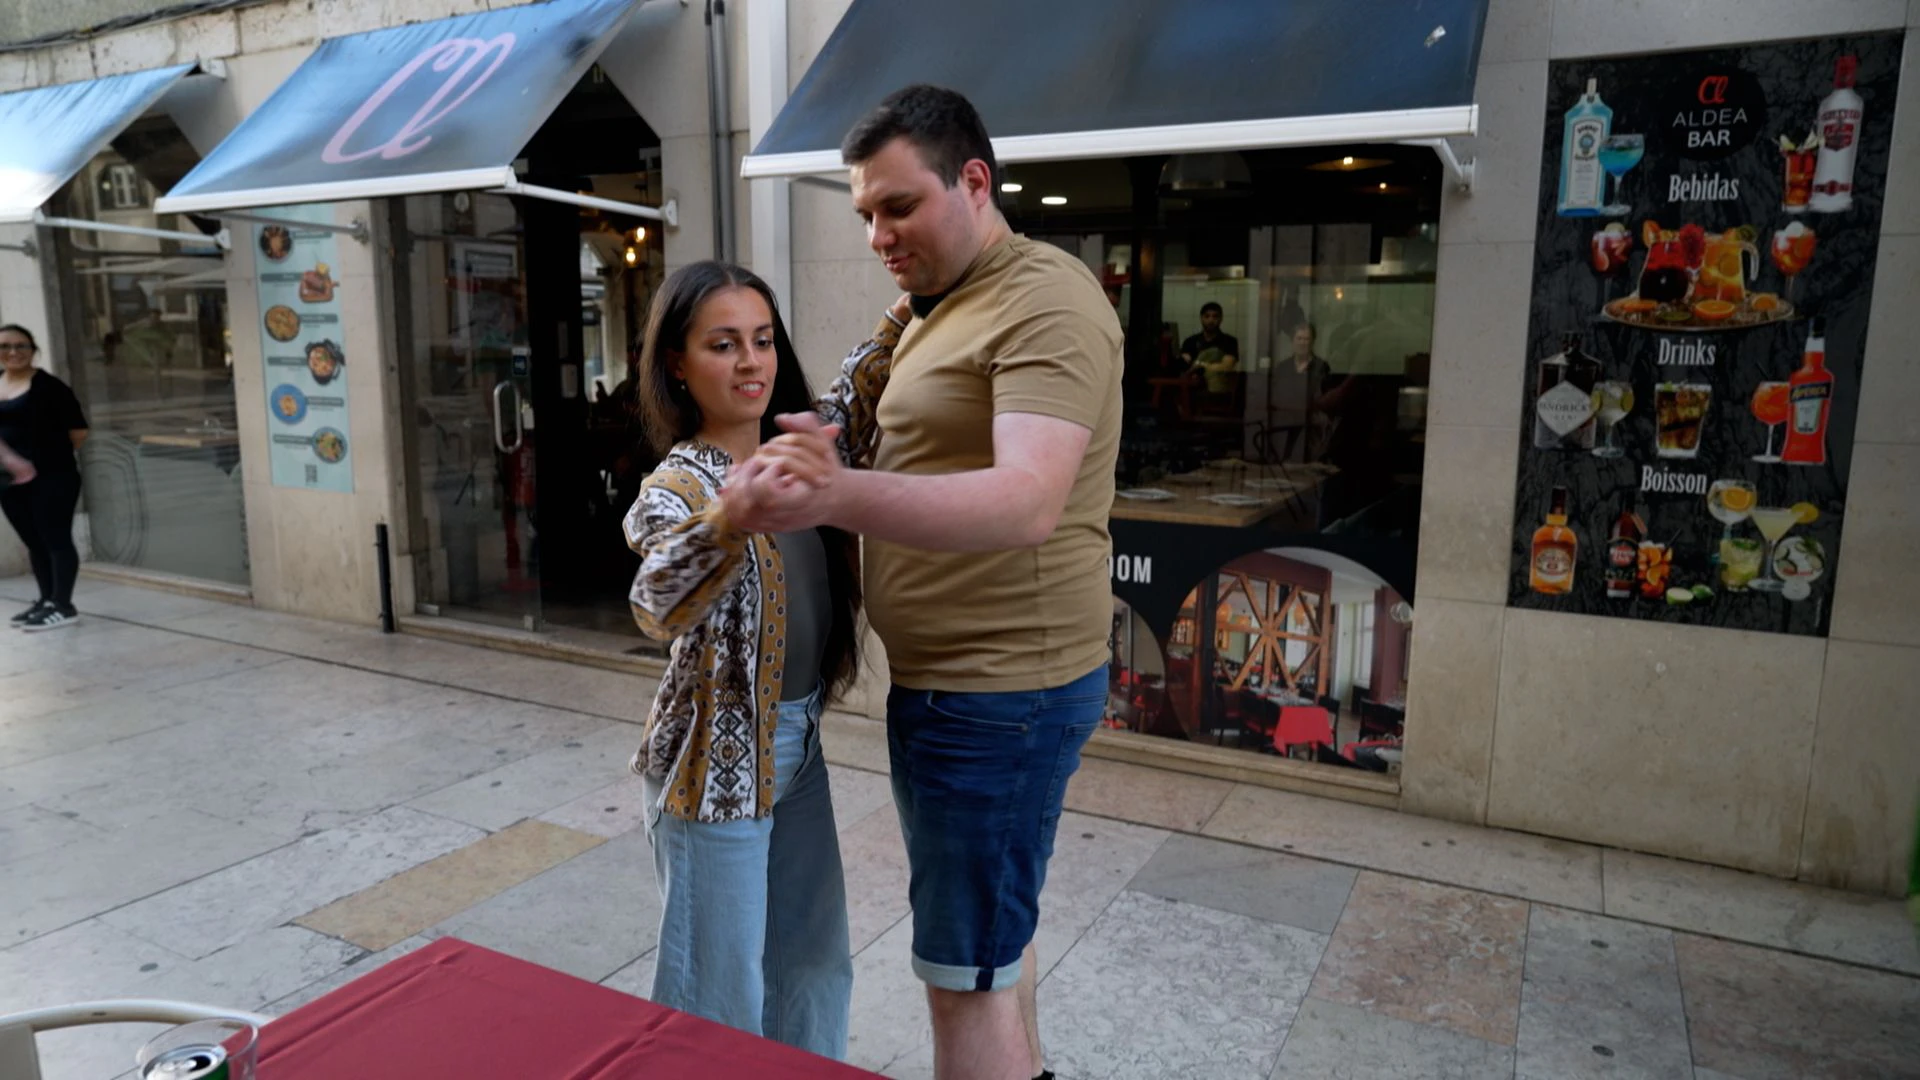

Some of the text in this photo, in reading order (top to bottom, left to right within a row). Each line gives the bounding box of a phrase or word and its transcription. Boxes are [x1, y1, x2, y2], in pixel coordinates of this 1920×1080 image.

[1672, 107, 1748, 128] ALDEA
[1687, 129, 1731, 148] BAR
[1667, 172, 1740, 203] Bebidas
[1657, 336, 1717, 366] Drinks
[1640, 465, 1708, 495] Boisson
